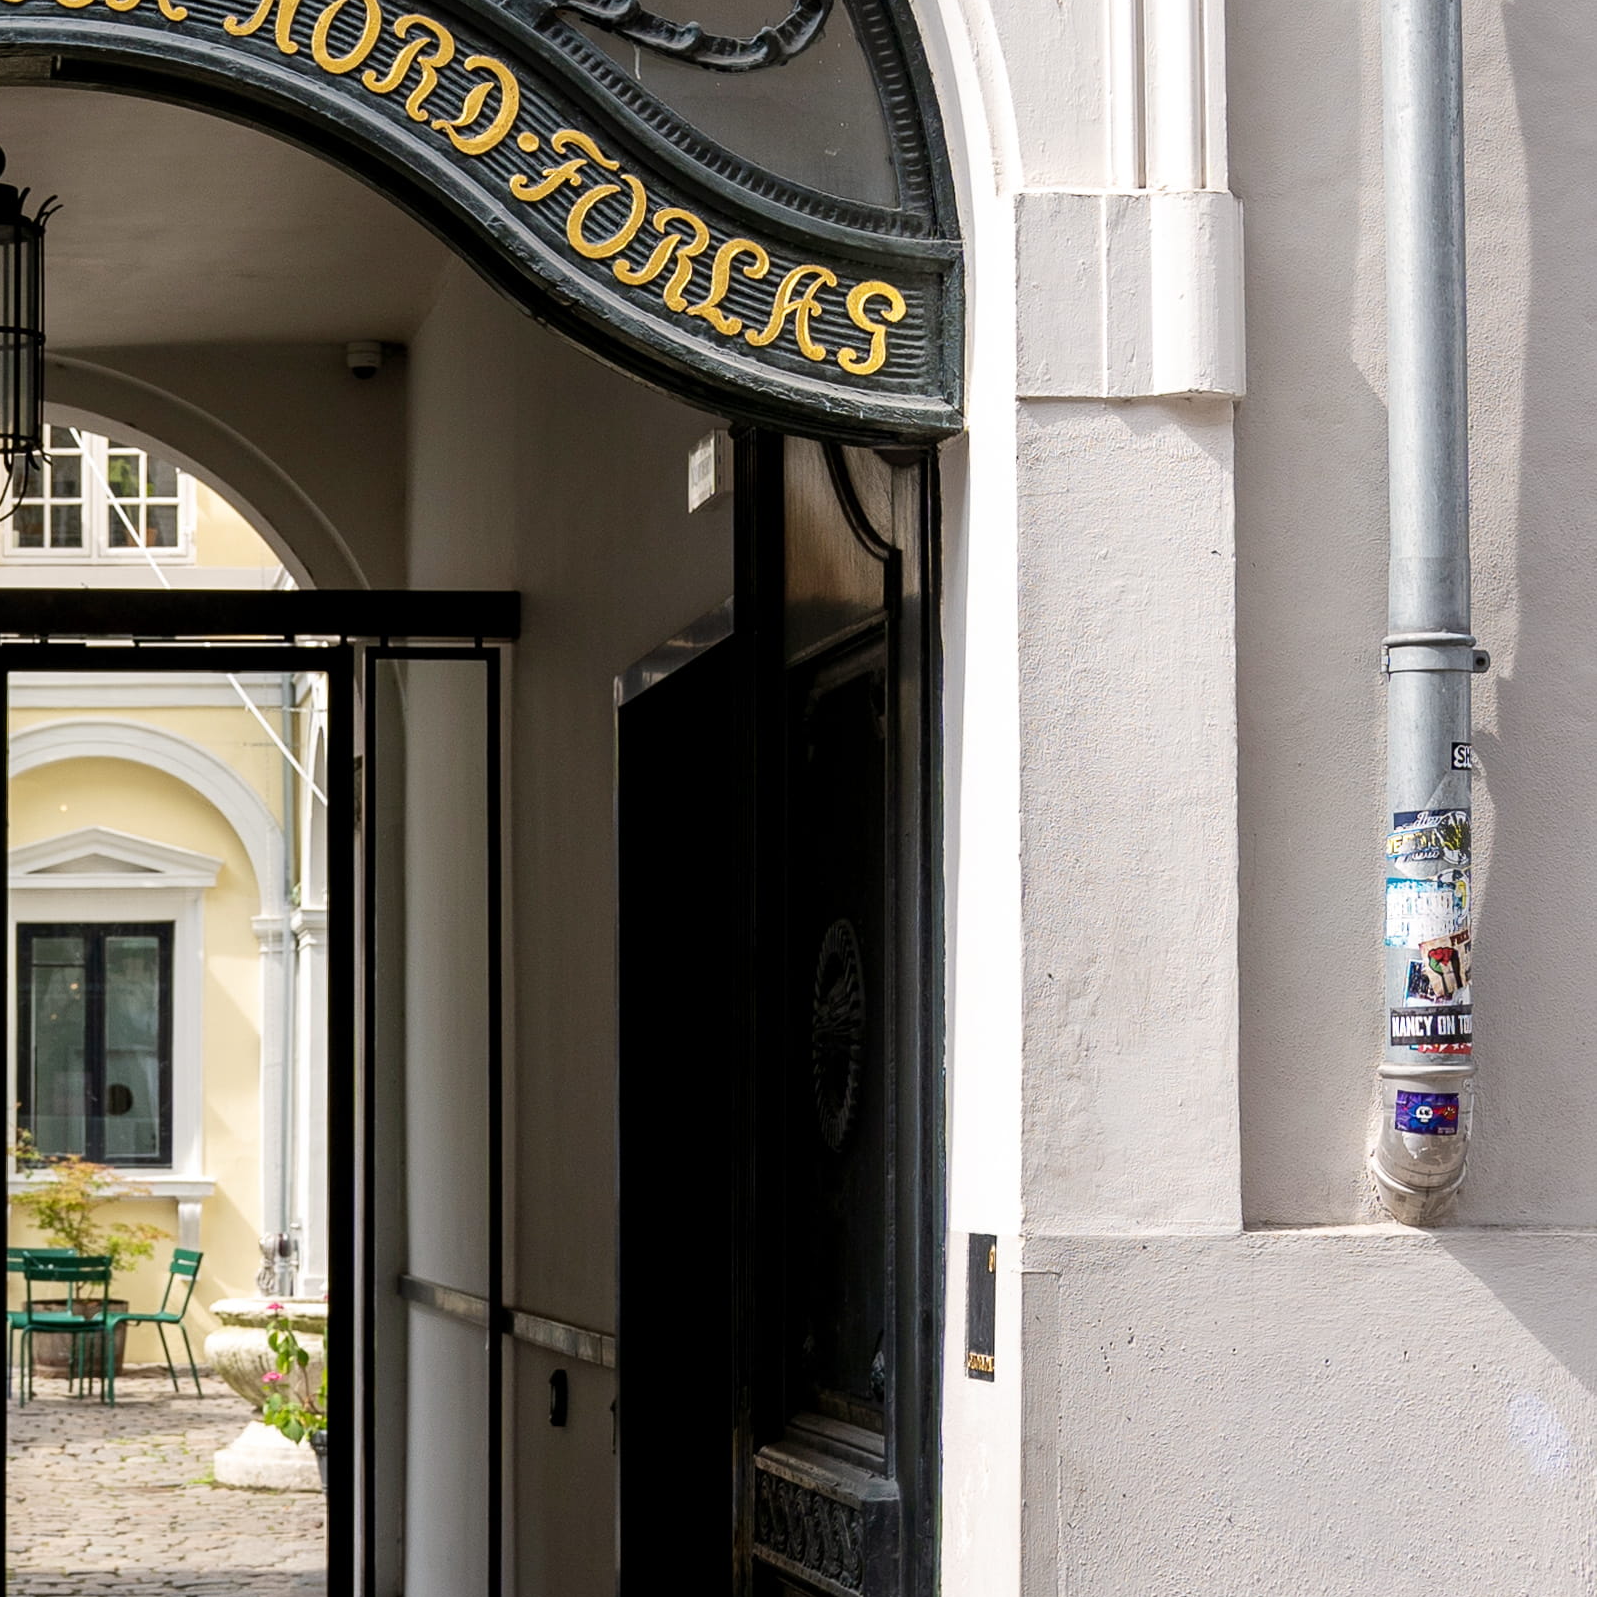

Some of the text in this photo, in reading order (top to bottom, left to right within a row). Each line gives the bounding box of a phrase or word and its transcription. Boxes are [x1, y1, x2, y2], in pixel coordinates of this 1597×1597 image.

[509, 129, 908, 377] FORLAG
[1391, 1015, 1433, 1038] NANCY
[1437, 1013, 1456, 1036] ON
